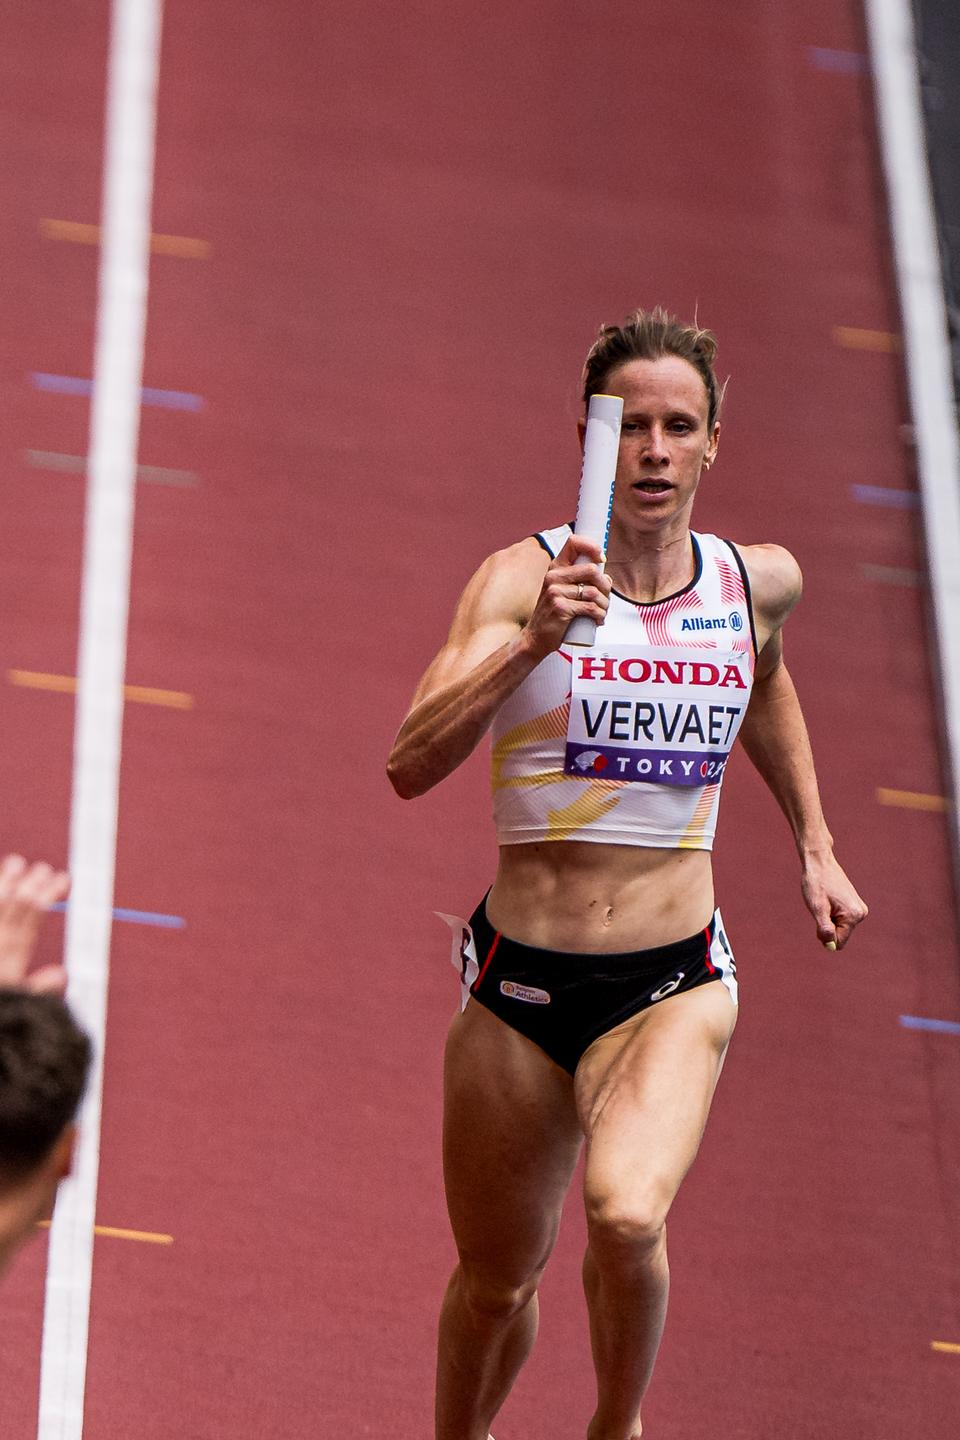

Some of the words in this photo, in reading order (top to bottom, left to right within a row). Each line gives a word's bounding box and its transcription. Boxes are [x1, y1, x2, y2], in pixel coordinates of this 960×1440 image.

[681, 617, 727, 631] Allianz
[578, 657, 747, 689] HONDA
[581, 699, 741, 745] VERVAET
